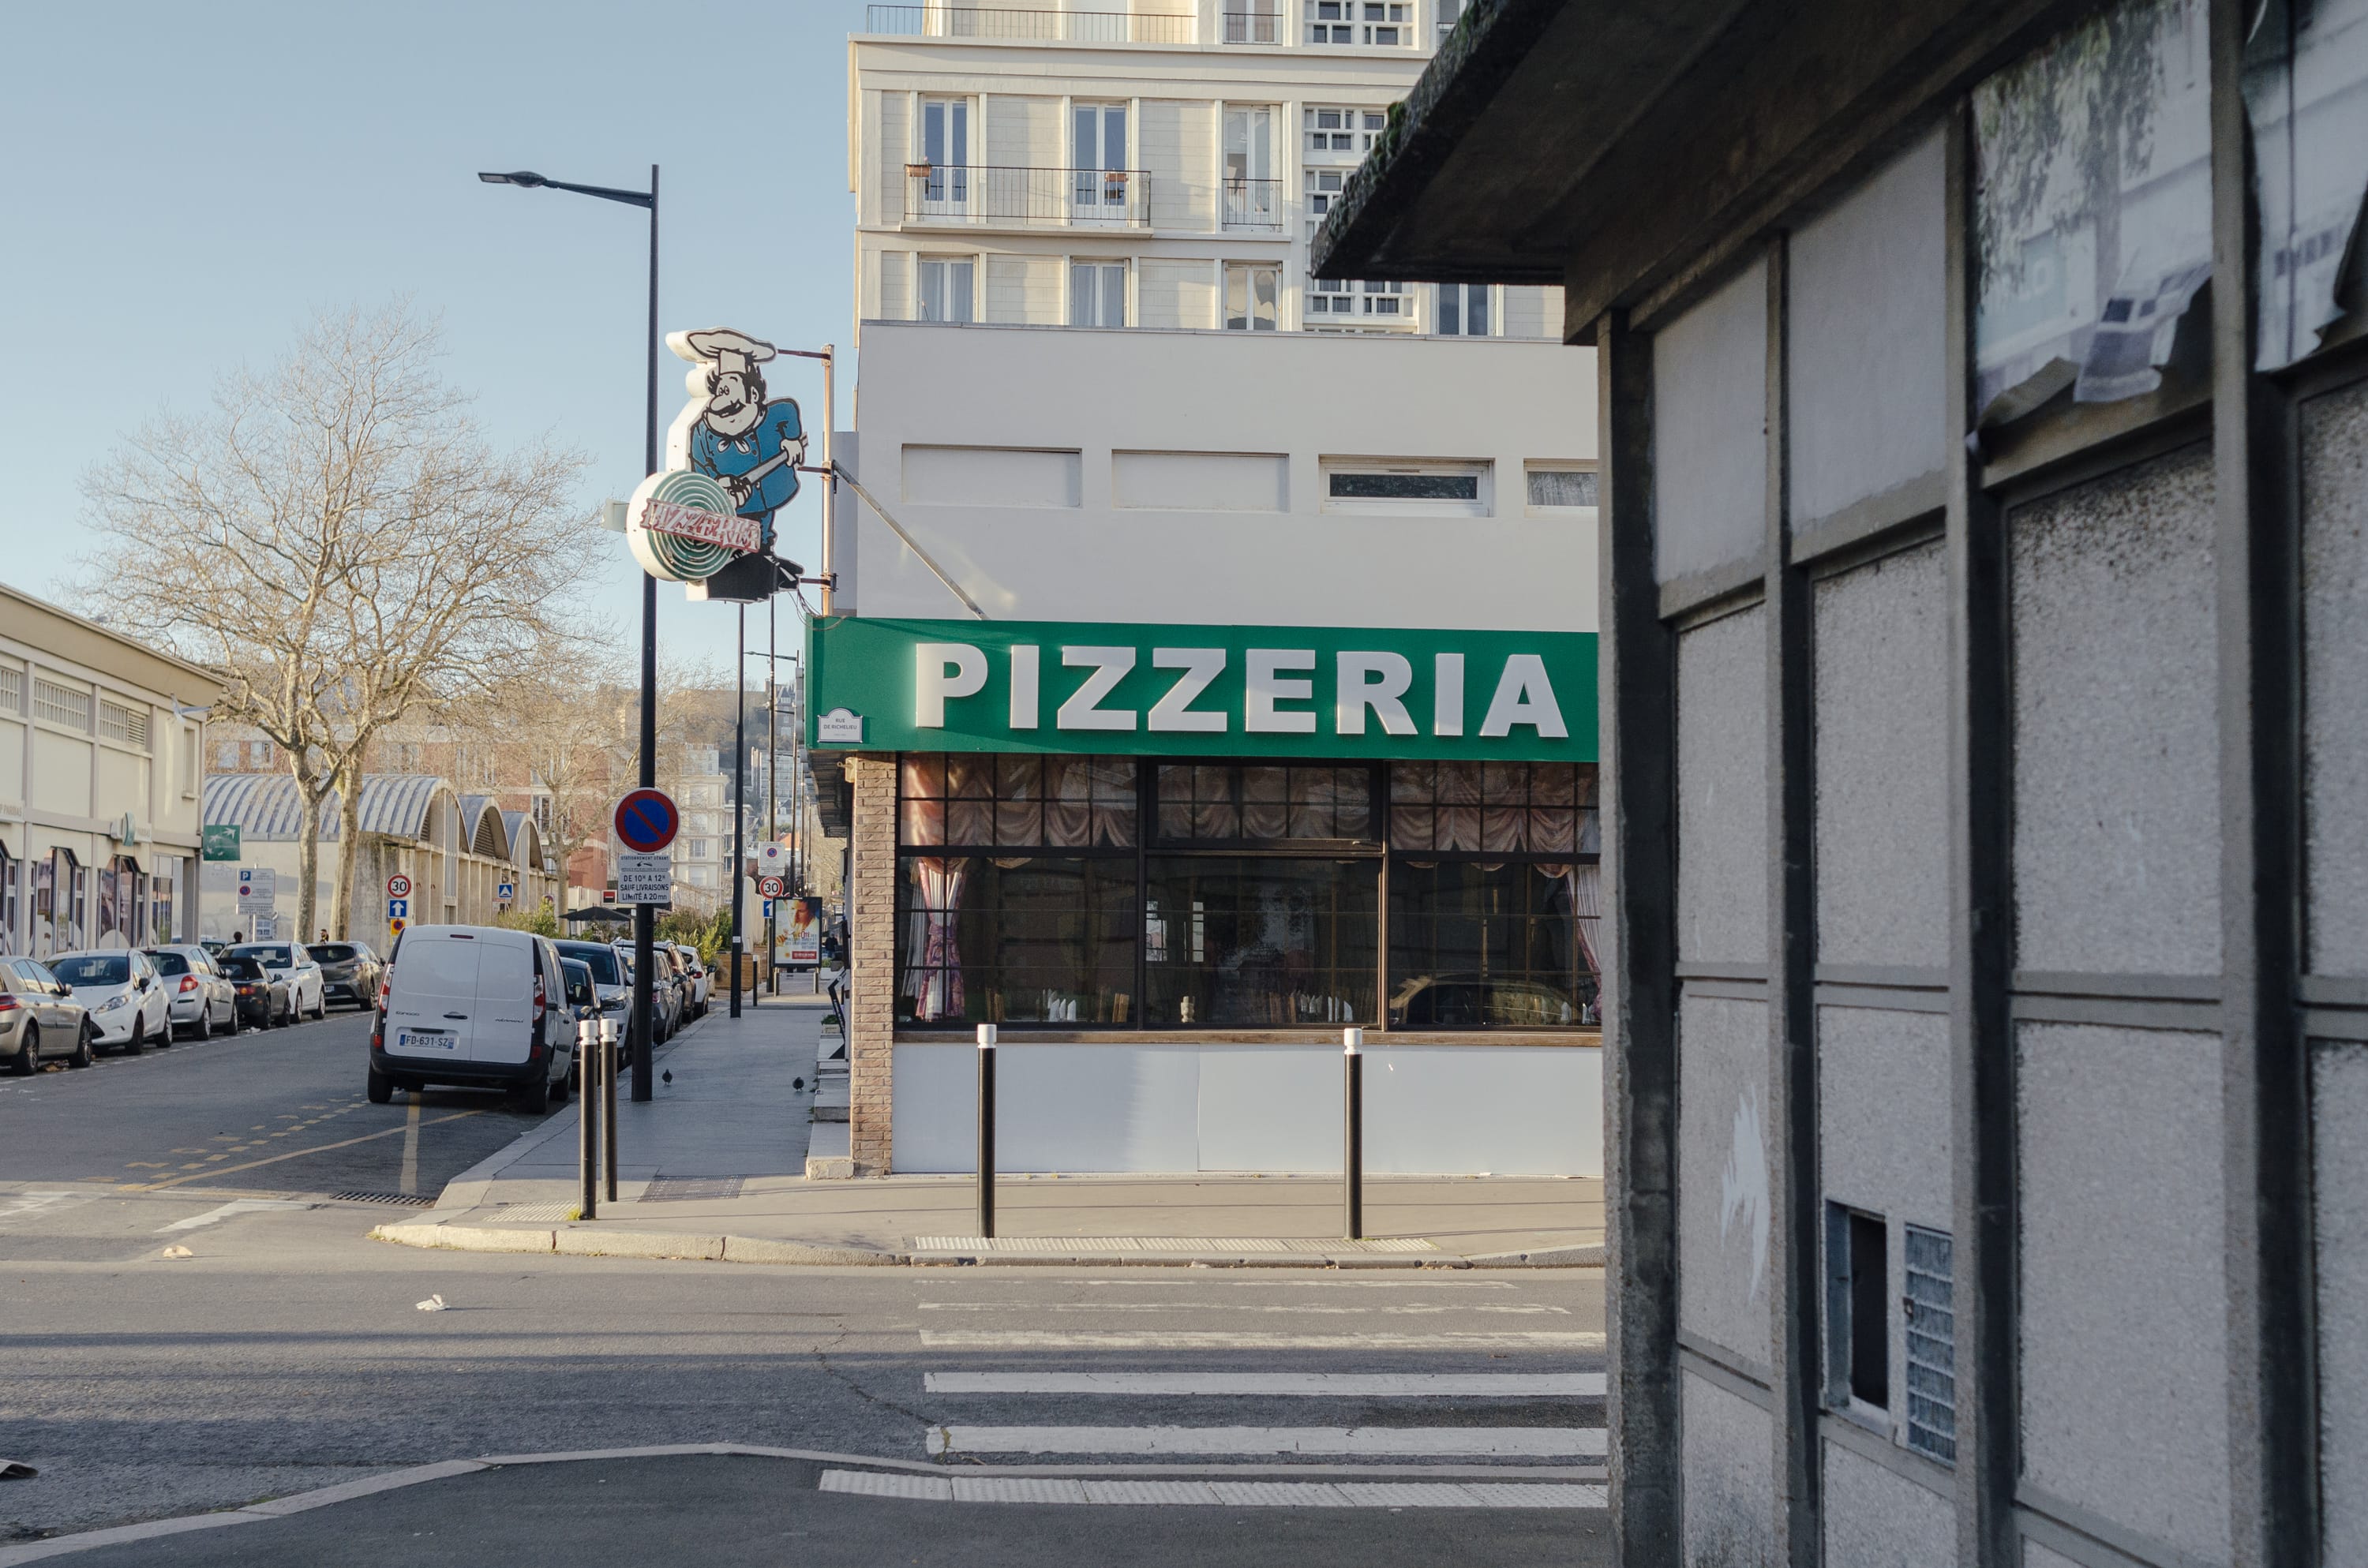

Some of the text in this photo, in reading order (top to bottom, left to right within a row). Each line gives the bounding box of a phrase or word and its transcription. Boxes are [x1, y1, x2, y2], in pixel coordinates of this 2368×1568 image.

[916, 643, 1569, 739] PIZZERIA
[392, 881, 407, 891] 30
[765, 883, 779, 893] 30
[406, 1035, 448, 1047] FD-631-SZ
